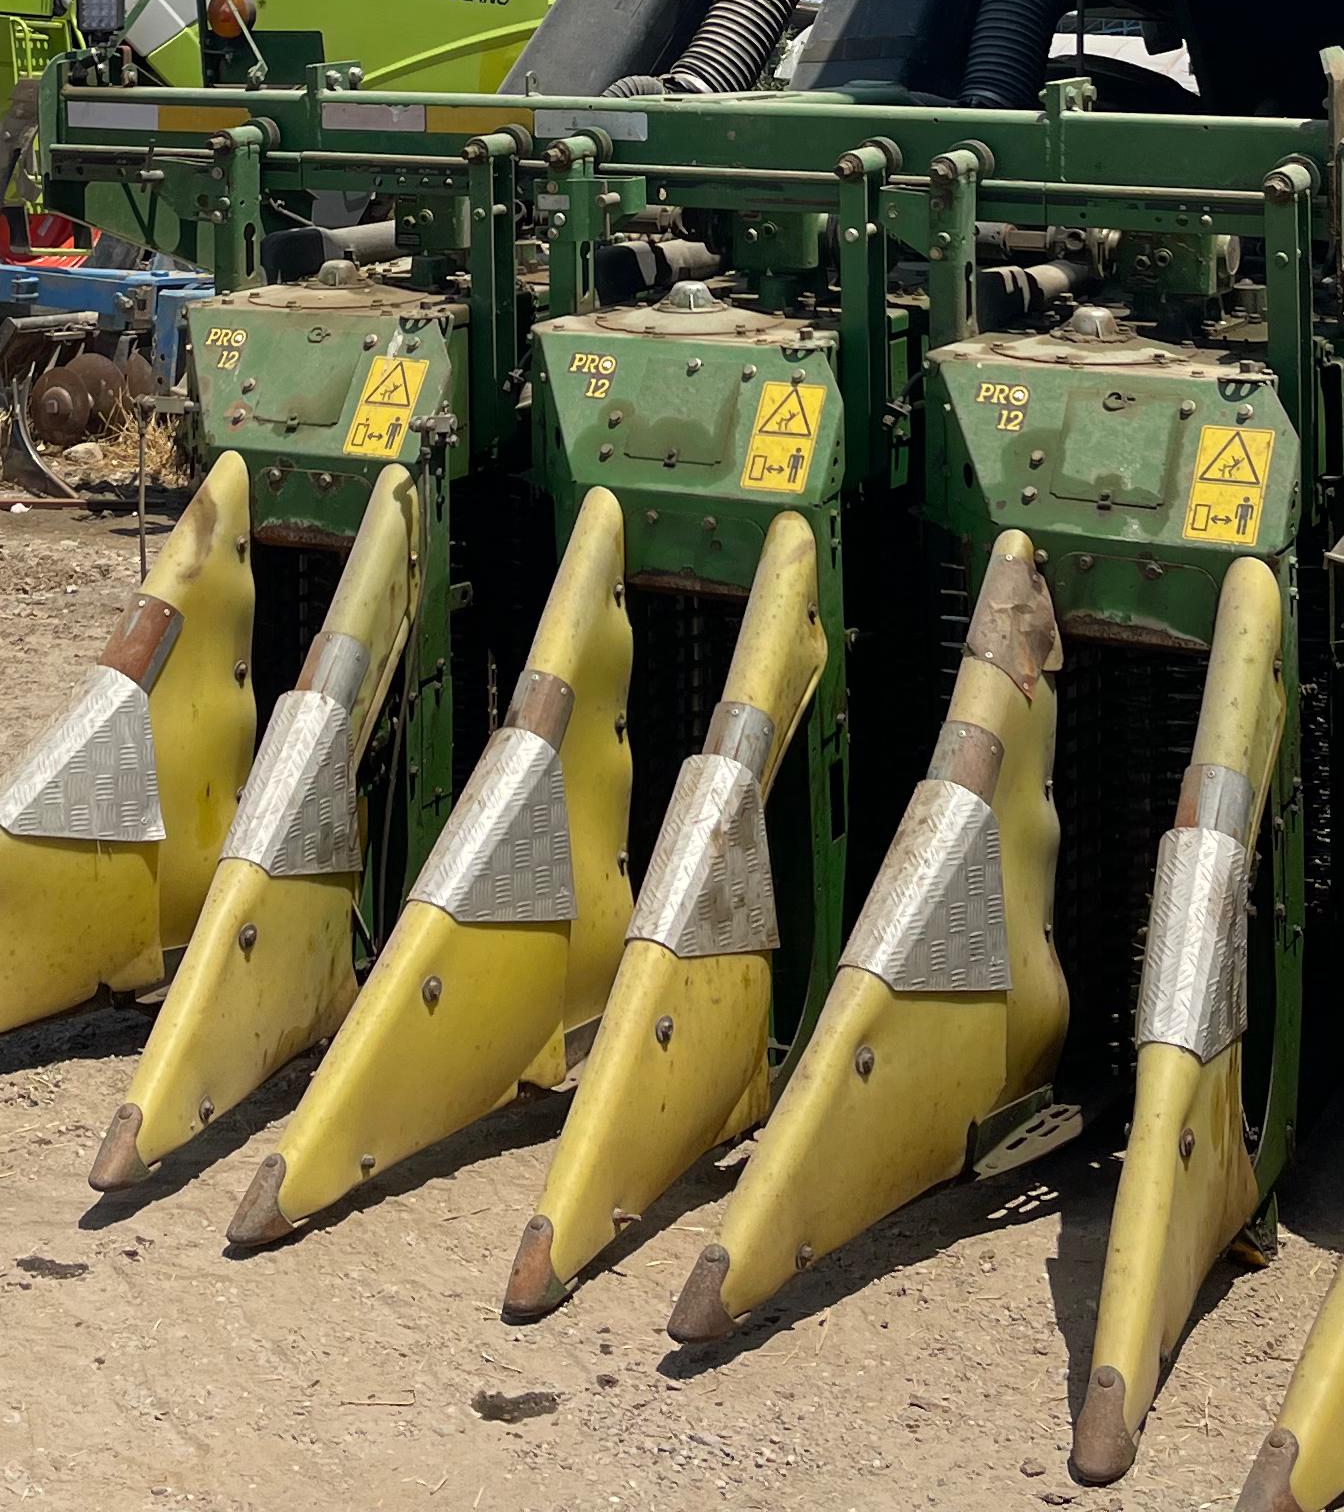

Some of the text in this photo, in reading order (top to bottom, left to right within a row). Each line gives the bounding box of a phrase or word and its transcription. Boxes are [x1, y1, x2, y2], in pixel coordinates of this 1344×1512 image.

[205, 328, 247, 347] PRO
[217, 350, 239, 370] 12
[569, 353, 616, 375] PRO
[585, 378, 609, 398] 12
[976, 383, 1029, 406] PRO
[997, 409, 1024, 431] 12
